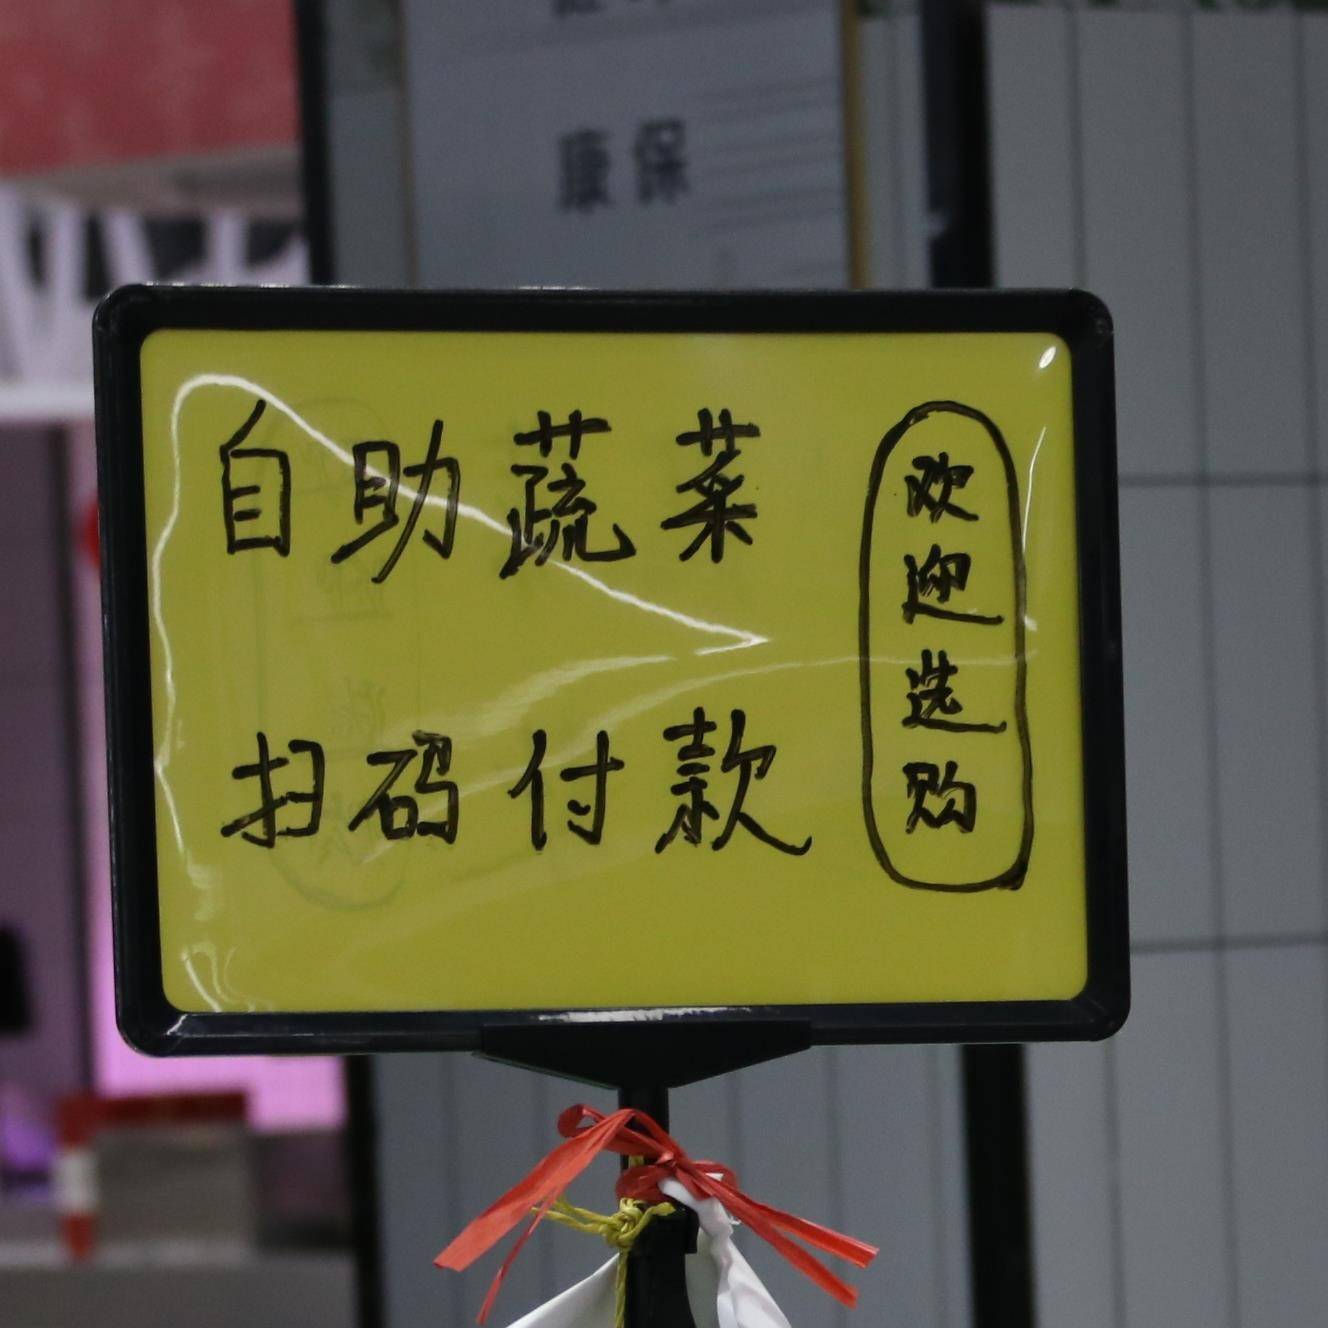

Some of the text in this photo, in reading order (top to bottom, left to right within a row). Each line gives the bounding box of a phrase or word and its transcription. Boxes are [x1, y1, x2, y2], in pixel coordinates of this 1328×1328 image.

[219, 400, 760, 583] 自助蔬菜
[903, 453, 1007, 835] 欢迎选购
[221, 708, 811, 857] 扫码付款
